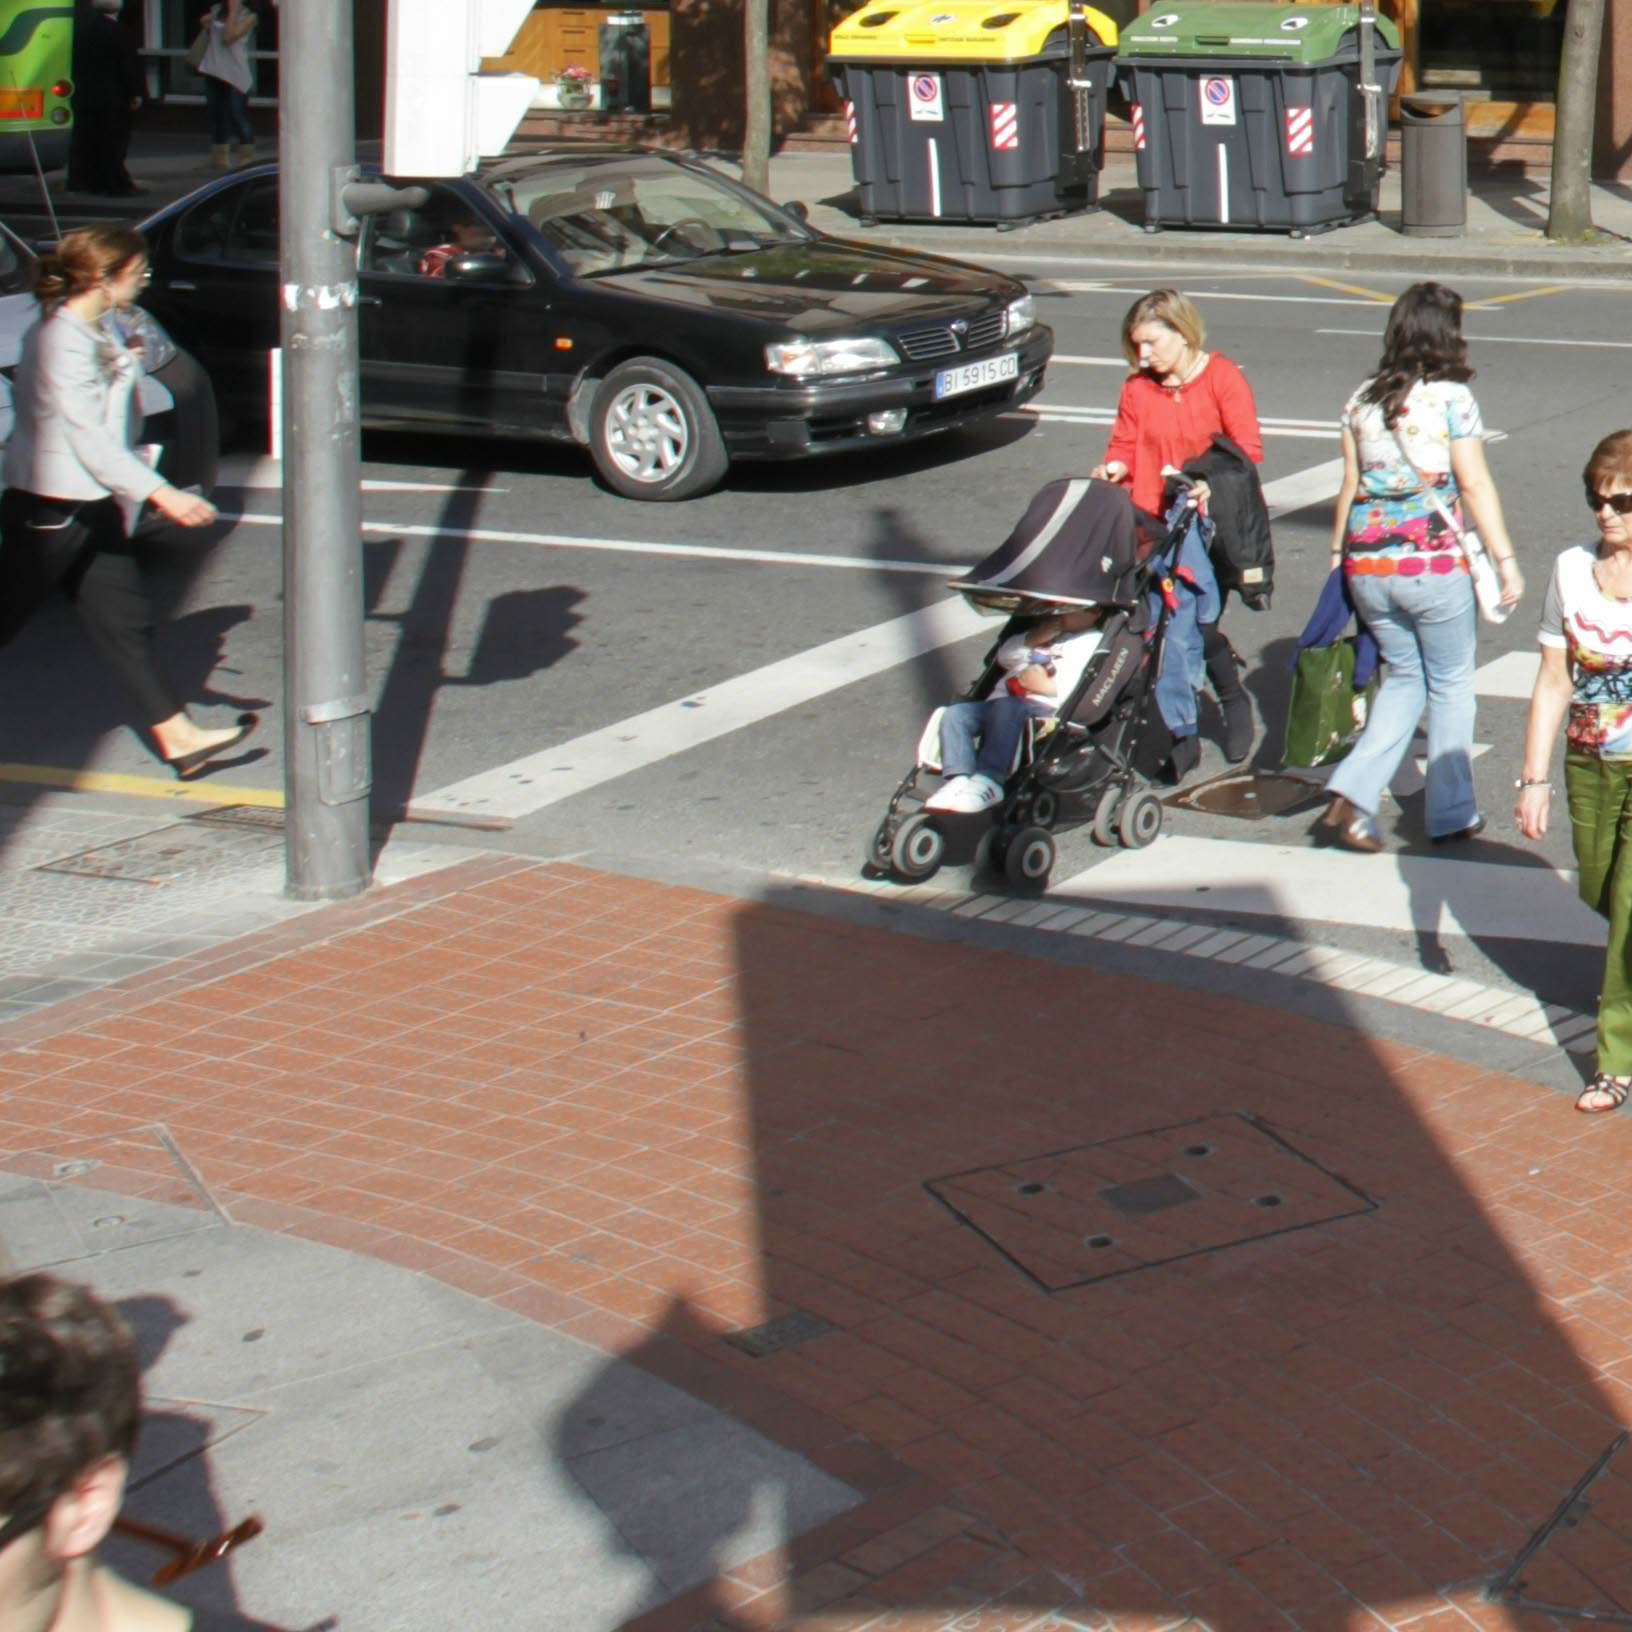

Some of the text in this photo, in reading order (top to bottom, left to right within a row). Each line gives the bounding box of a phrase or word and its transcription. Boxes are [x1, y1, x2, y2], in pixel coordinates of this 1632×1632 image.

[944, 372, 958, 392] BI
[962, 362, 997, 386] 5915
[1092, 647, 1129, 707] MACLAREN
